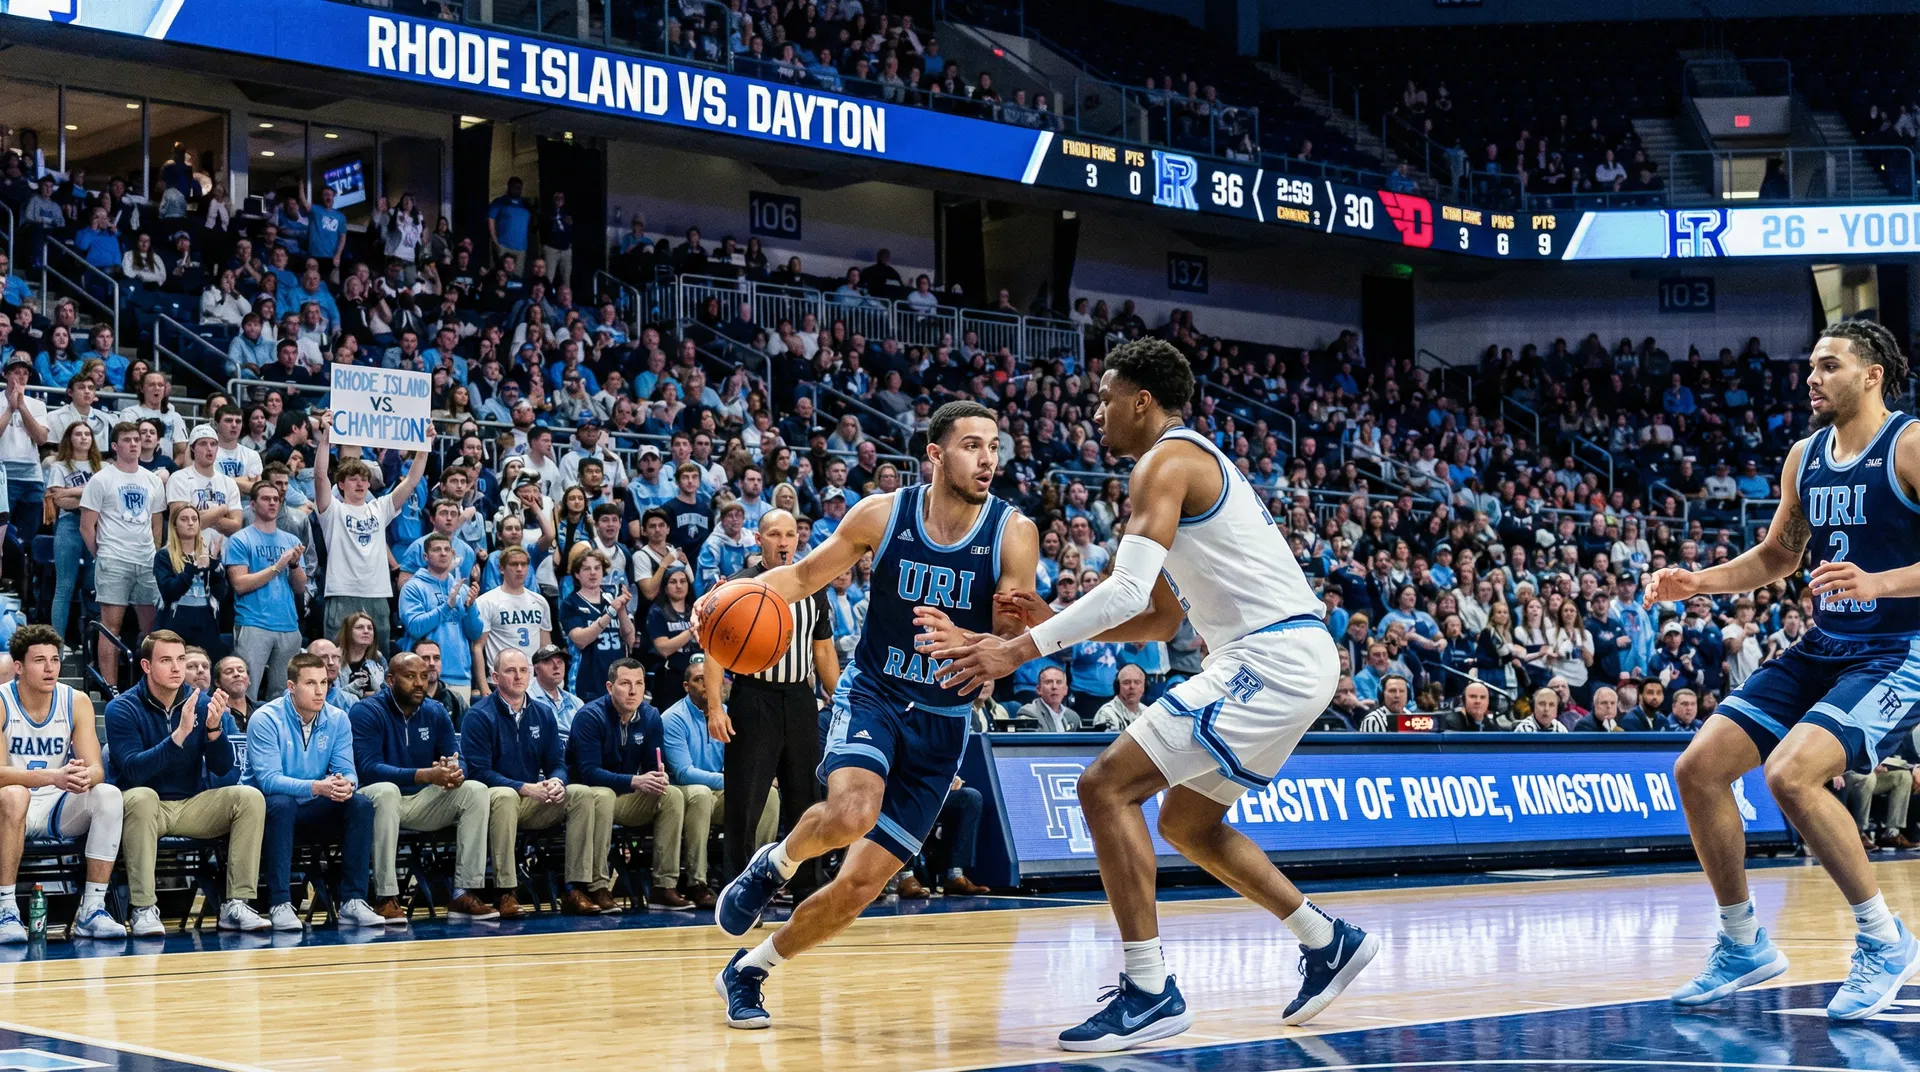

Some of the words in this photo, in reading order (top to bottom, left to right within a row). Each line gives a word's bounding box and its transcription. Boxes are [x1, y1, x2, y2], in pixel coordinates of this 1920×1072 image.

[368, 16, 510, 89] RHODE
[521, 43, 669, 116] ISLAND
[679, 71, 737, 128] VS.
[747, 84, 886, 153] DAYTON
[1086, 163, 1098, 188] 3
[1129, 171, 1141, 195] 0
[1211, 170, 1244, 208] 36
[1276, 177, 1314, 206] 2:59
[752, 199, 797, 232] 106
[1344, 193, 1374, 230] 30
[1532, 215, 1556, 230] PTS
[1459, 227, 1469, 249] 3
[1497, 233, 1509, 256] 6
[1538, 233, 1551, 256] 9
[1762, 215, 1805, 248] 26
[1840, 211, 1920, 248] YOO
[1661, 283, 1710, 308] 103
[334, 369, 379, 392] RHODE
[383, 374, 430, 398] ISLAND
[370, 396, 395, 413] VS.
[333, 410, 431, 443] CHAMPION
[1809, 485, 1867, 526] URI
[1829, 531, 1849, 563] 2
[897, 559, 975, 609] URI
[500, 610, 542, 625] RAMS
[517, 627, 530, 647] 3
[597, 631, 621, 650] 35
[883, 646, 966, 685] RAM
[9, 736, 64, 756] RAMS
[1355, 777, 1396, 820] OF
[1400, 775, 1513, 823] RHODE,
[1512, 773, 1649, 819] KINGSTON,
[1646, 772, 1677, 811] RI
